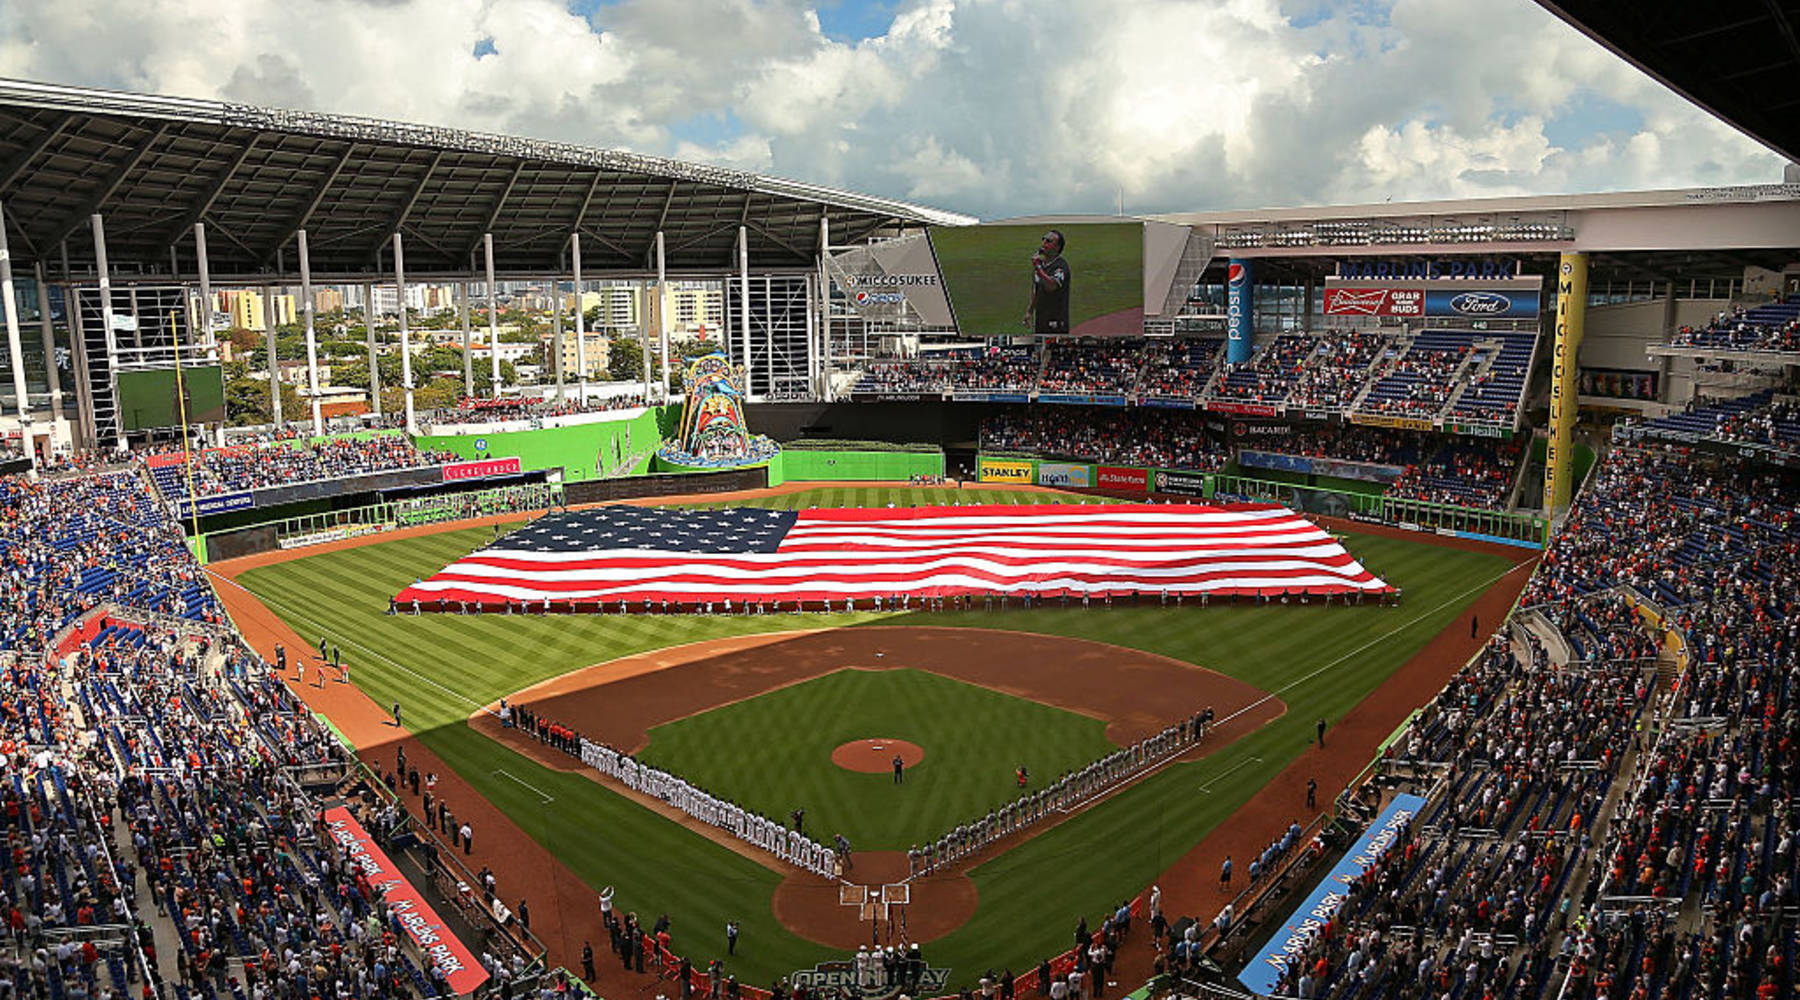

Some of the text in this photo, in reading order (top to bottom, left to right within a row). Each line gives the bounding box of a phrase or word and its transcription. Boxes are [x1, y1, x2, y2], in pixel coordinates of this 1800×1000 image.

[1340, 261, 1513, 280] MARLINS PARK
[857, 275, 937, 286] MICCOSUKEE
[1391, 291, 1421, 300] GRAB
[1391, 304, 1420, 314] BUDS
[1461, 297, 1499, 312] Ford
[1228, 290, 1242, 340] pepsi
[983, 467, 1030, 478] STANLEY
[430, 944, 464, 976] PARK
